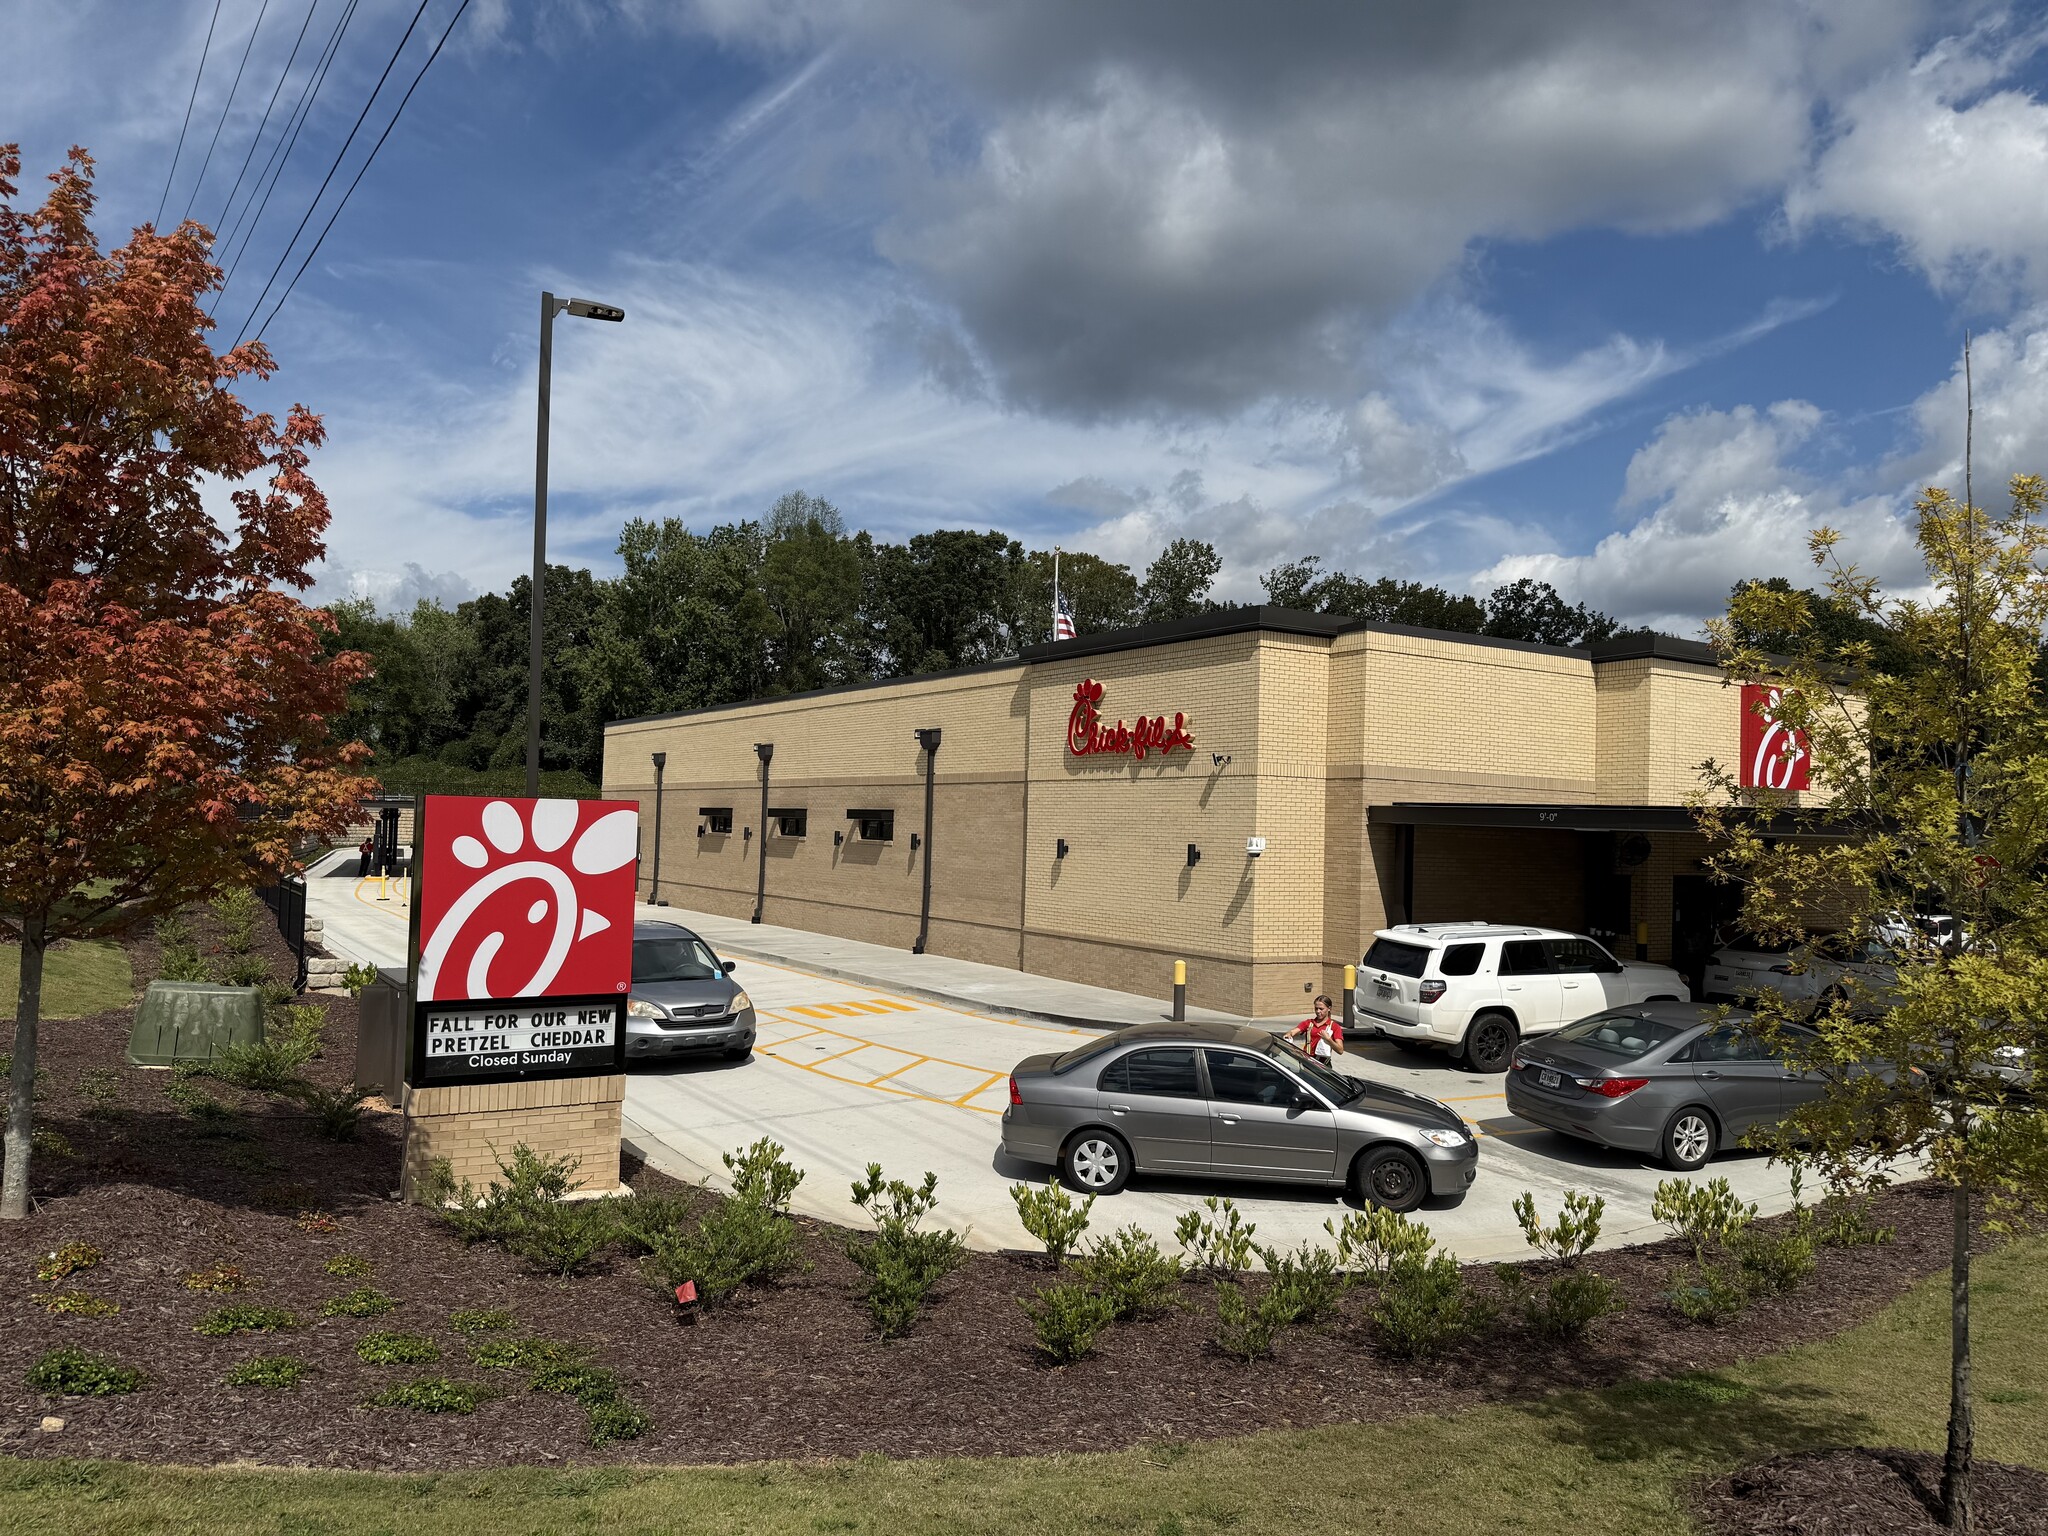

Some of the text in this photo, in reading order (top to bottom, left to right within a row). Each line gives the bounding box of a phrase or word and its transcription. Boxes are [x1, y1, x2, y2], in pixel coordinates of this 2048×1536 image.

[1067, 679, 1195, 760] Chick-fil-A
[429, 1009, 612, 1033] FALL FOR OUR NEW
[432, 1029, 606, 1054] PRETZEL CHEDDAR
[468, 1050, 572, 1068] Closed Sunday
